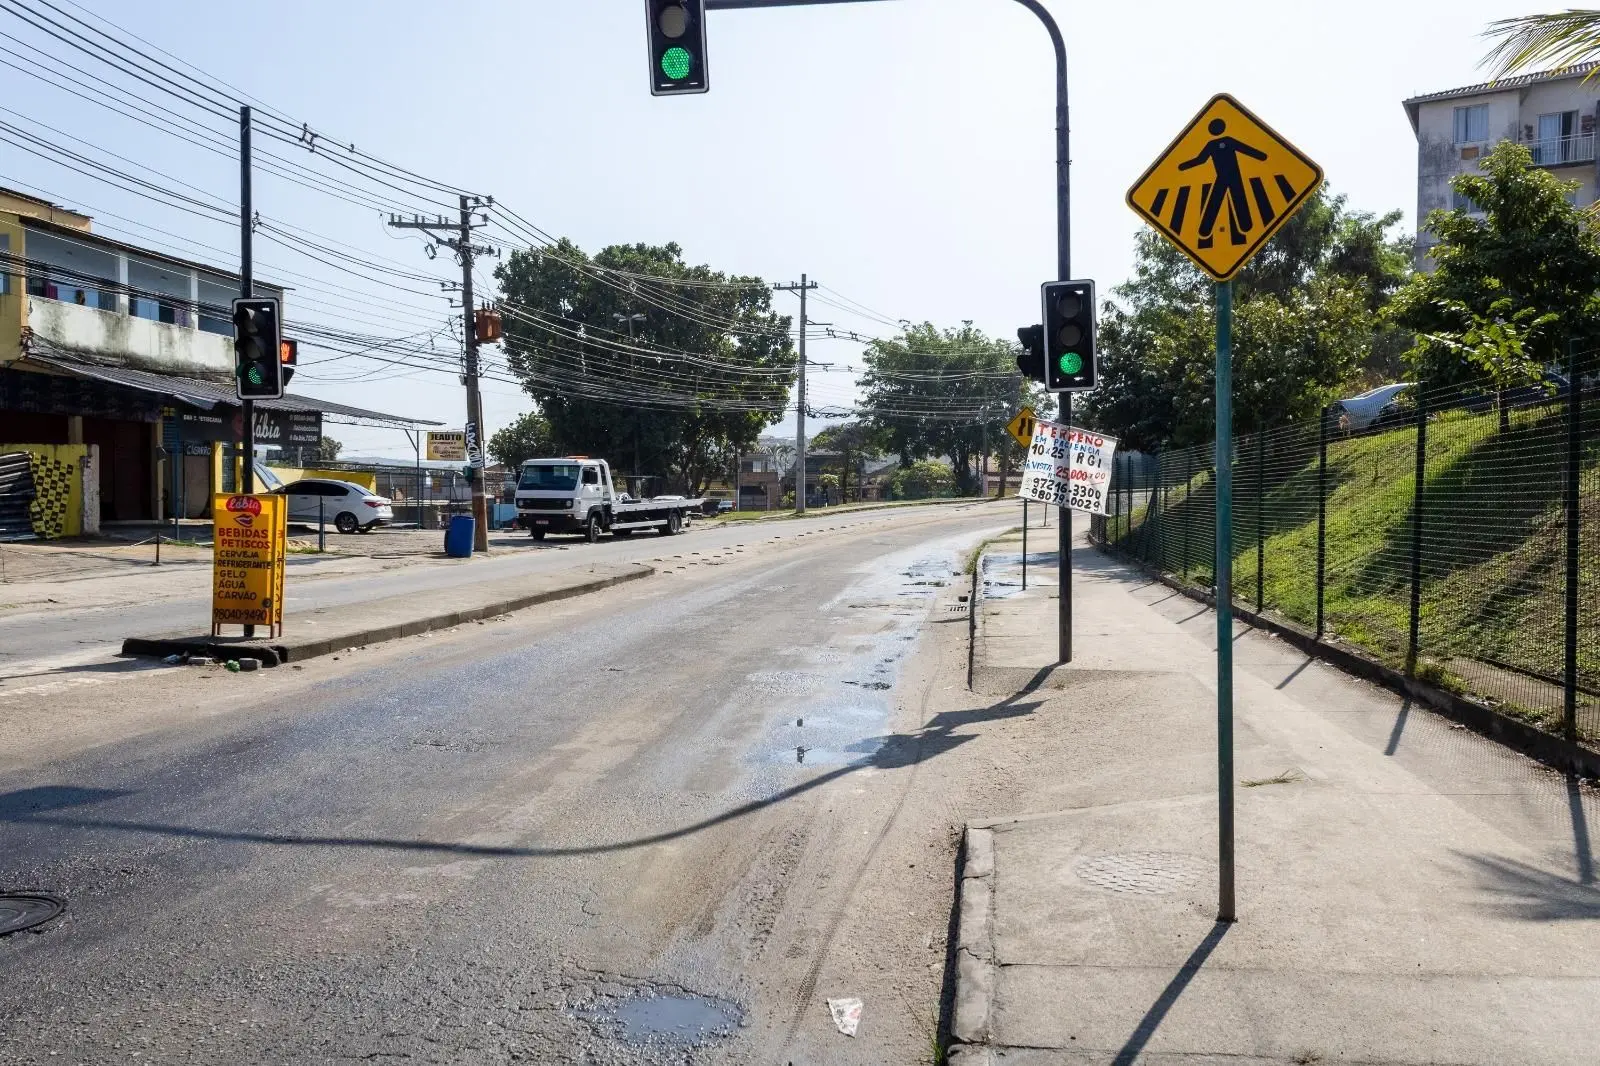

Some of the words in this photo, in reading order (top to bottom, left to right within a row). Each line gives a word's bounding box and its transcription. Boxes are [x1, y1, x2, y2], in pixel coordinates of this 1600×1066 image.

[1035, 435, 1047, 445] EM
[1039, 423, 1104, 447] TERRENO
[1031, 444, 1045, 455] 10
[1051, 446, 1065, 459] 25
[1033, 477, 1102, 500] 97216-3300
[1031, 487, 1101, 512] 98079-0029
[218, 527, 269, 539] BEBIDAS
[221, 539, 271, 550] PETISCOS
[219, 549, 260, 559] CERVEJA
[219, 569, 247, 579] GELO
